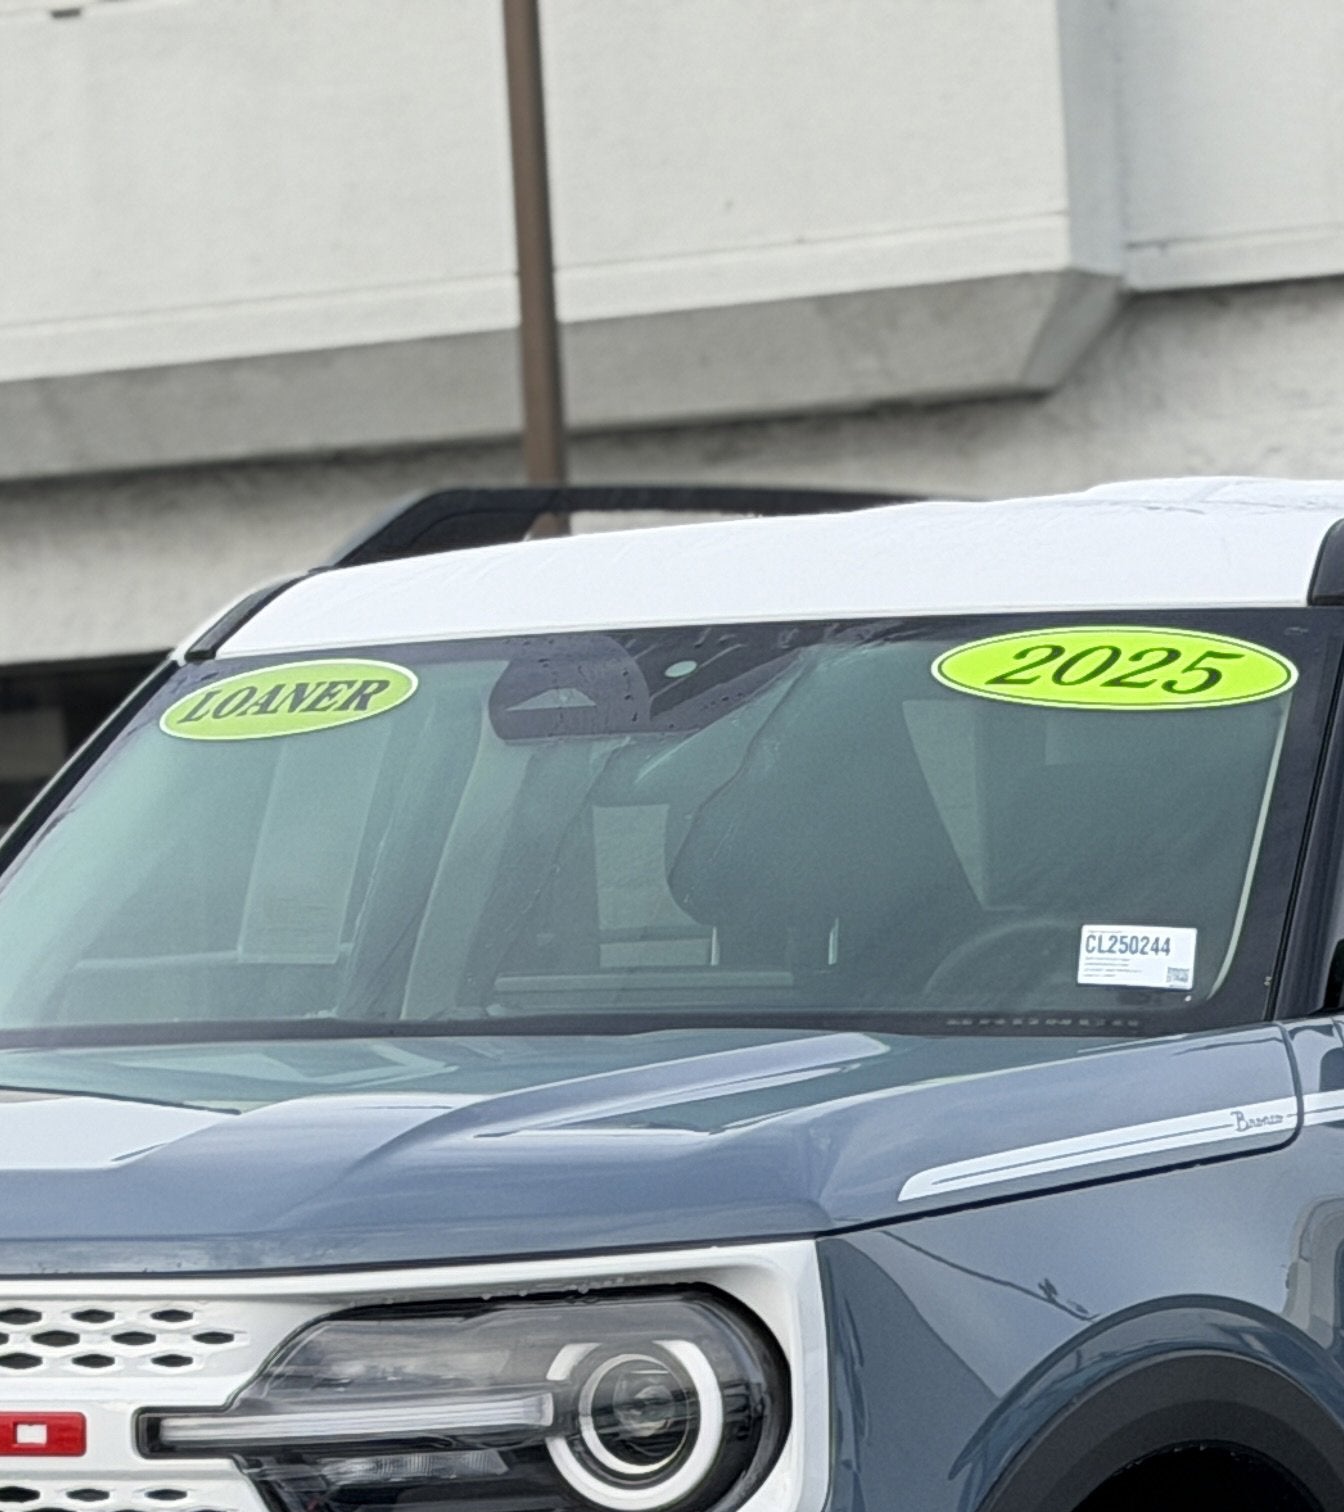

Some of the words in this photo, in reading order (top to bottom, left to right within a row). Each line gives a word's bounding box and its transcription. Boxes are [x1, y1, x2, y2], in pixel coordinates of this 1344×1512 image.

[985, 644, 1246, 695] 2025
[176, 679, 391, 724] LOANER
[1085, 934, 1171, 956] CL250244
